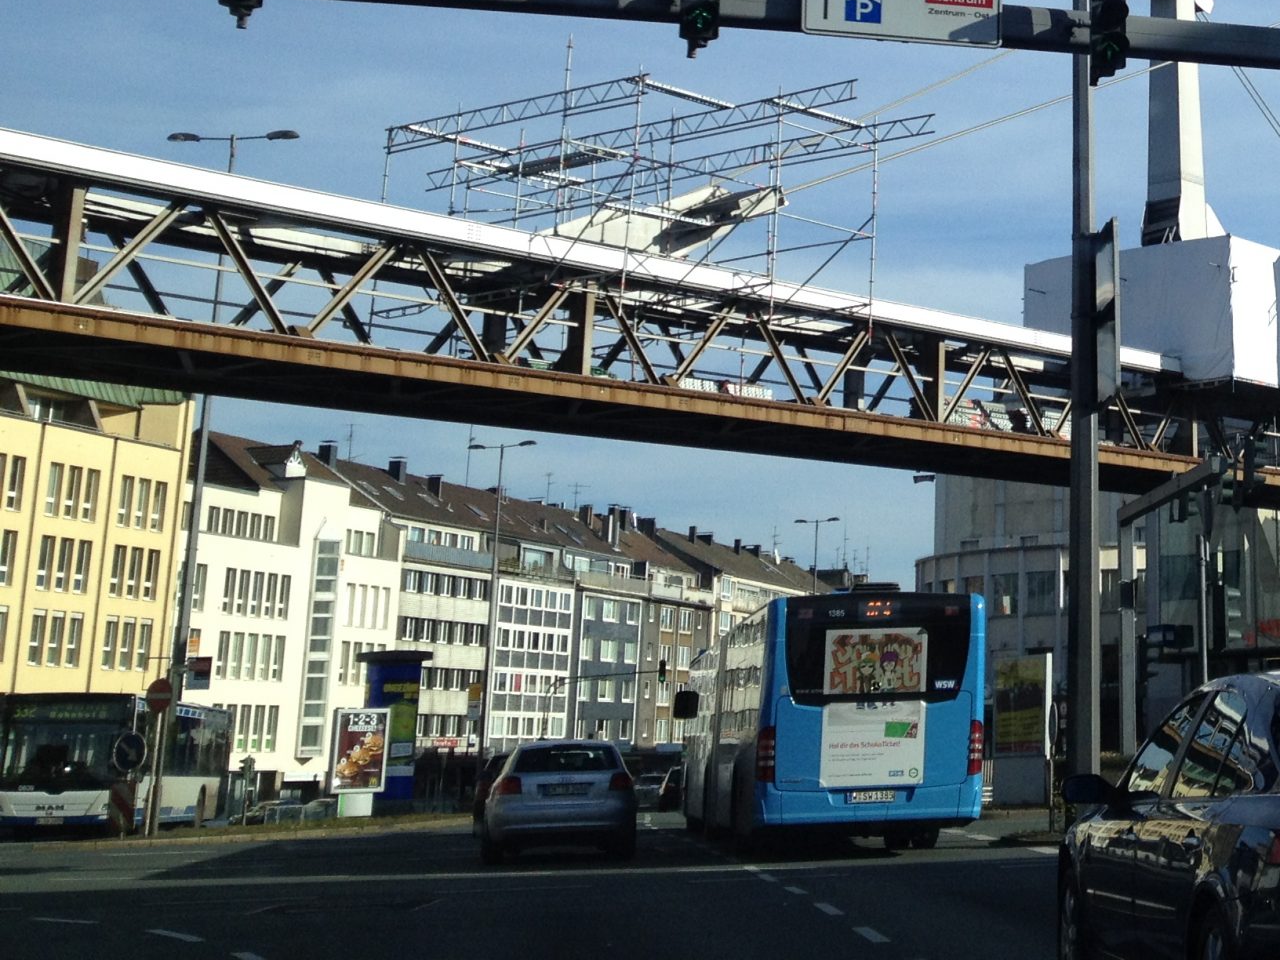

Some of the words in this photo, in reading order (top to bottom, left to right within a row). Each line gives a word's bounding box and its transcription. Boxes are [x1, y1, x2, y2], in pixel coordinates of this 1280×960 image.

[928, 8, 965, 16] Zentrum
[974, 12, 990, 20] Ost
[348, 714, 377, 725] 1-2-3
